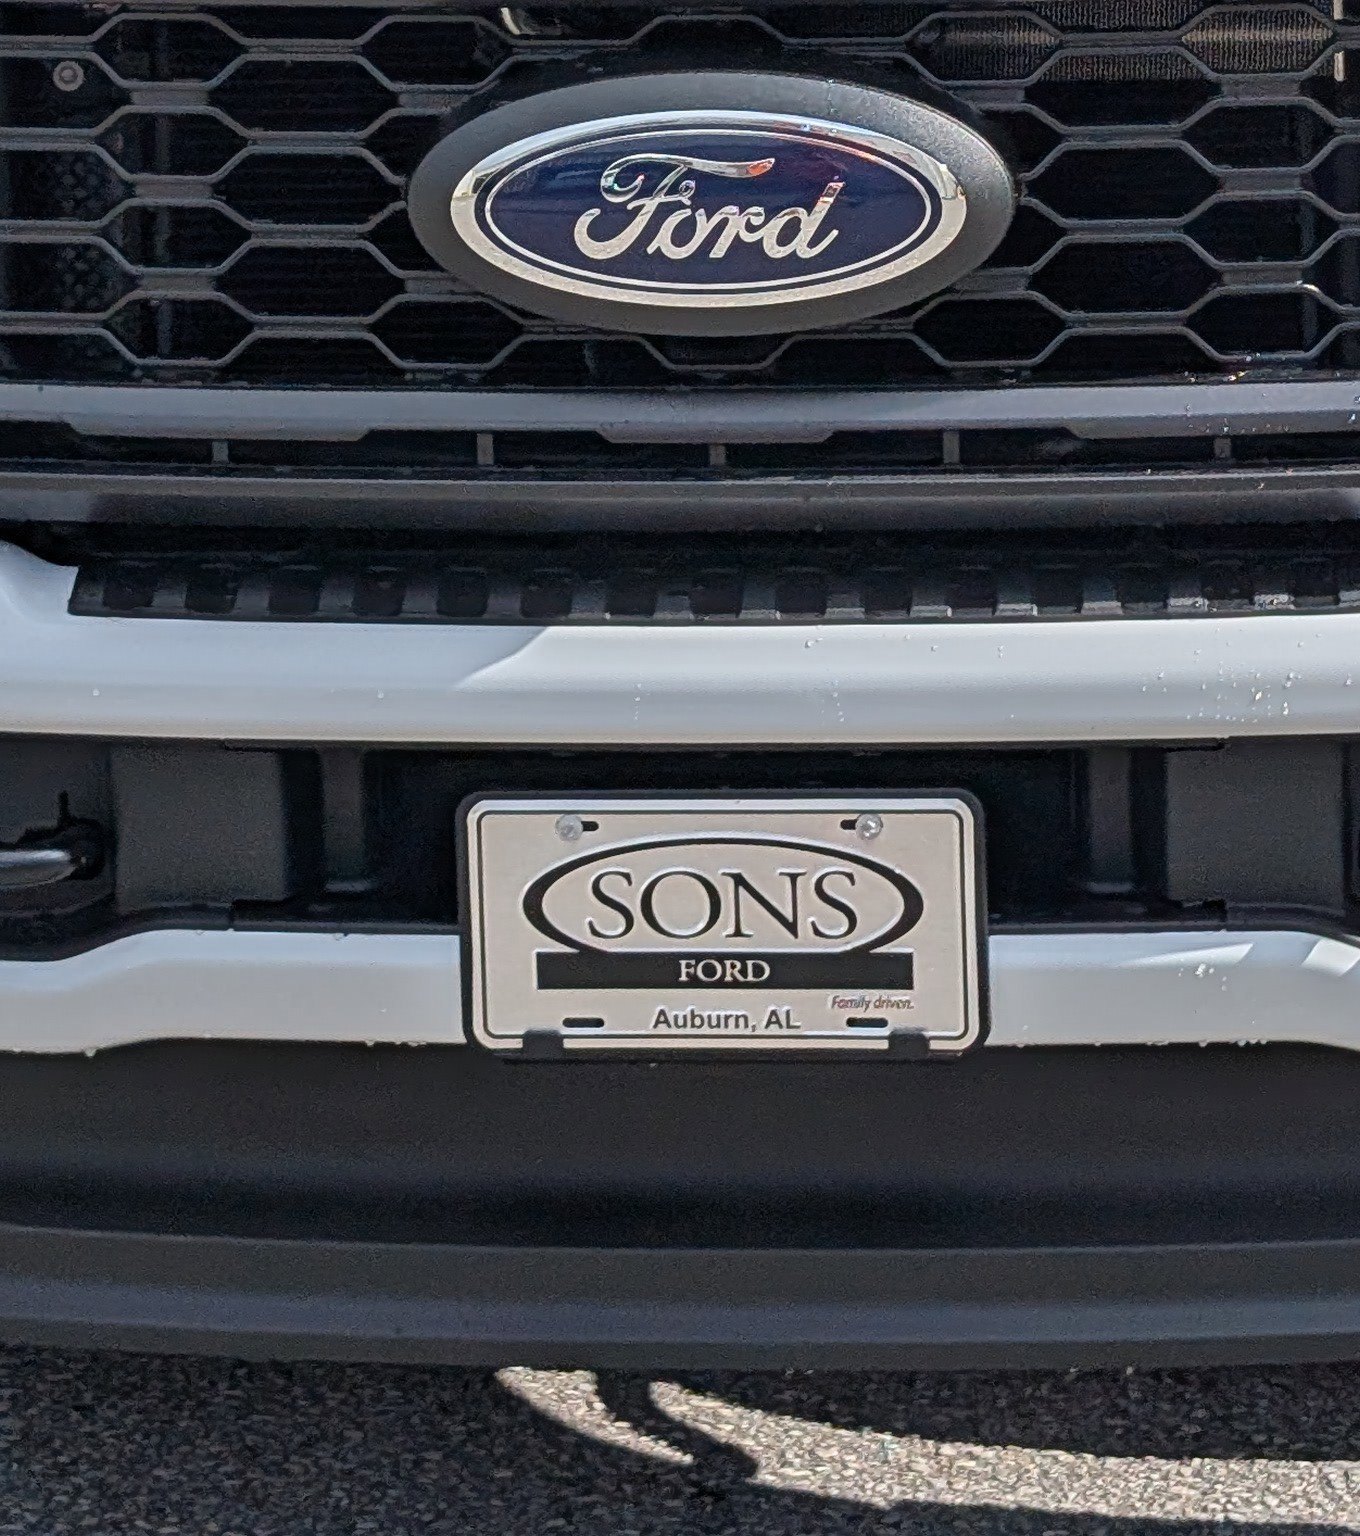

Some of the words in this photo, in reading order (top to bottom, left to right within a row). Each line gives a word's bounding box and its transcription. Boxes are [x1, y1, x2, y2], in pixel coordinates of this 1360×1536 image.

[574, 153, 845, 261] Ford
[586, 869, 858, 941] SONS
[677, 958, 771, 983] FORD
[652, 1007, 757, 1033] Auburn,
[763, 1007, 801, 1030] AL
